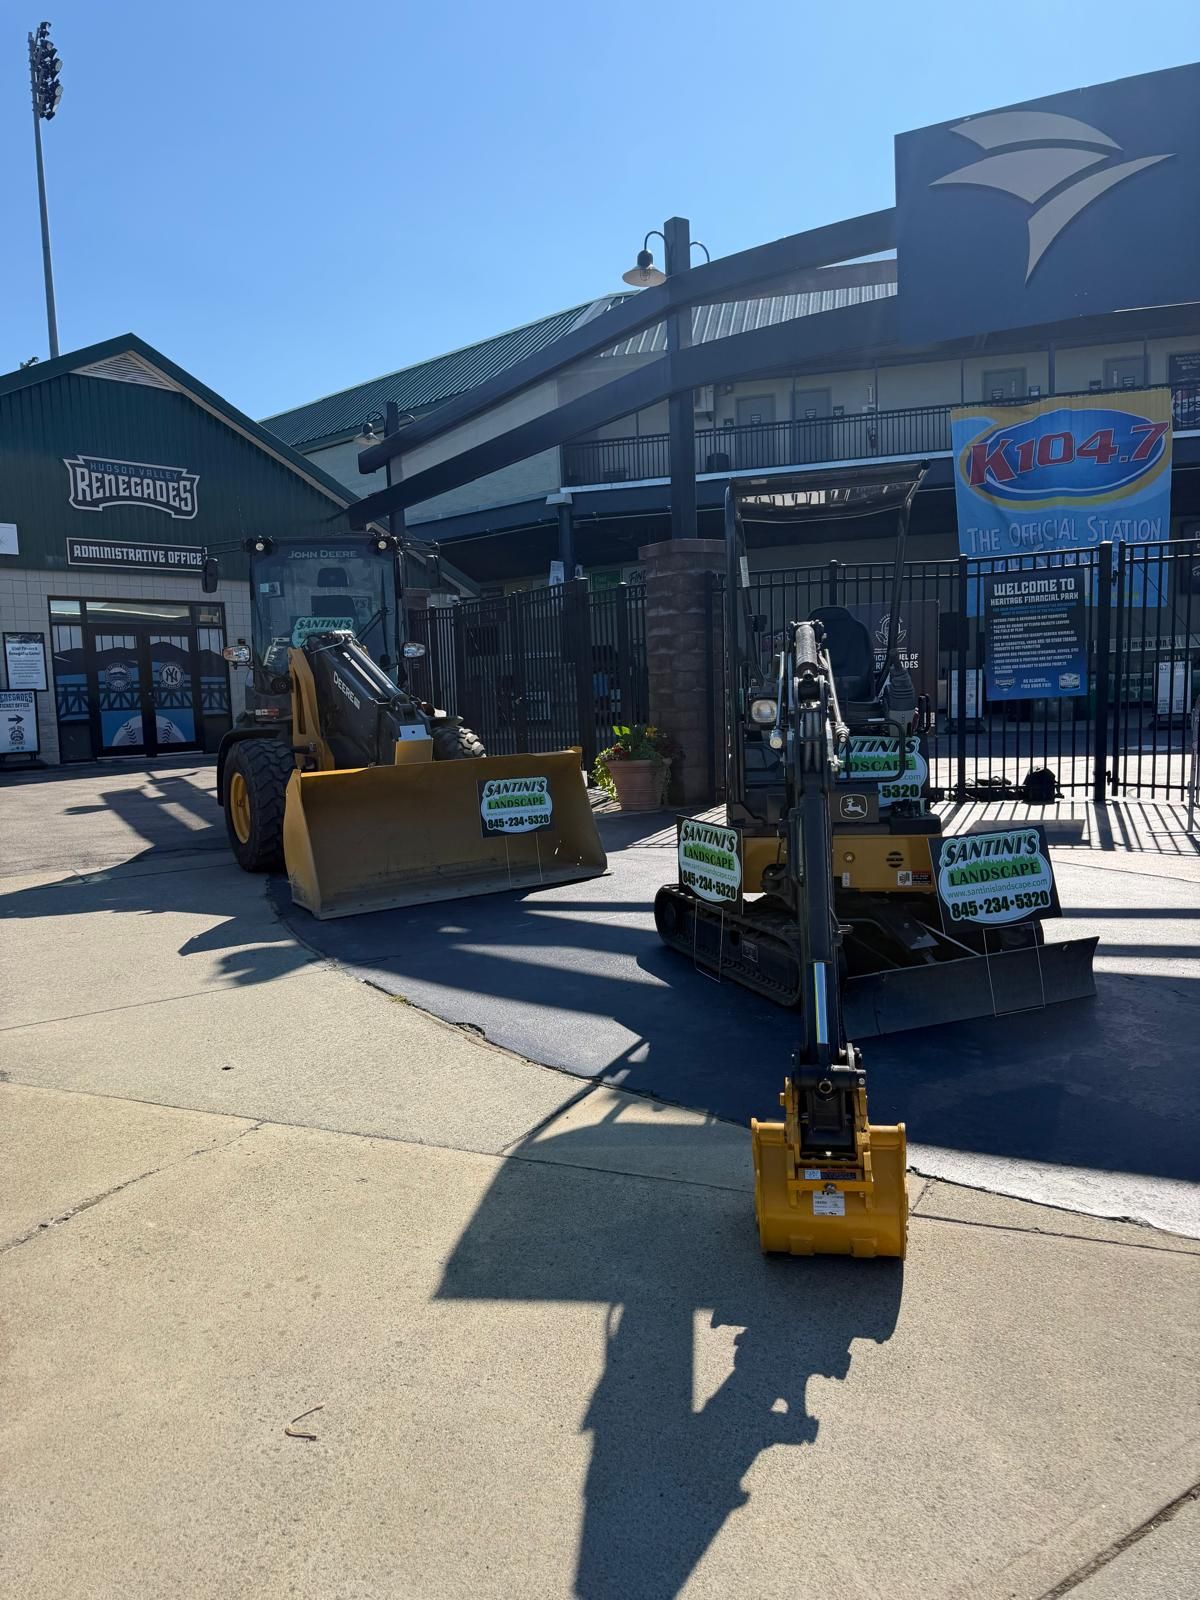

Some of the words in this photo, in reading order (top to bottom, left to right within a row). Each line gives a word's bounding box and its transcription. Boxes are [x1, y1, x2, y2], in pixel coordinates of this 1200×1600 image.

[970, 422, 1169, 487] K104.7
[90, 462, 135, 475] HUDSON
[139, 468, 179, 480] VALLEY
[75, 466, 193, 511] RENEGADES
[967, 527, 1001, 553] THE
[1009, 517, 1078, 547] OFFICIAL
[1087, 515, 1162, 542] STATION
[73, 544, 166, 563] ADMINISTRATIVE
[168, 551, 203, 566] OFFICE
[288, 550, 317, 559] JOHN
[319, 549, 357, 559] DEERE
[994, 579, 1057, 596] WELCOME
[1059, 577, 1075, 591] TO
[990, 596, 1023, 606] HERITAGE
[1024, 593, 1059, 604] FINANCIAL
[1060, 591, 1079, 601] PARK
[296, 618, 353, 629] SANTINI'S
[333, 671, 355, 704] DEERE
[486, 780, 545, 797] SANTINI'S
[488, 796, 546, 810] LANDSCAPE
[682, 825, 735, 852] SANTINI'S
[684, 846, 736, 871] LANDSCAPE
[945, 834, 1038, 867] SANTINI'S
[949, 861, 1042, 886] LANDSCAPE
[947, 879, 1048, 899] www.santinislandscape.com
